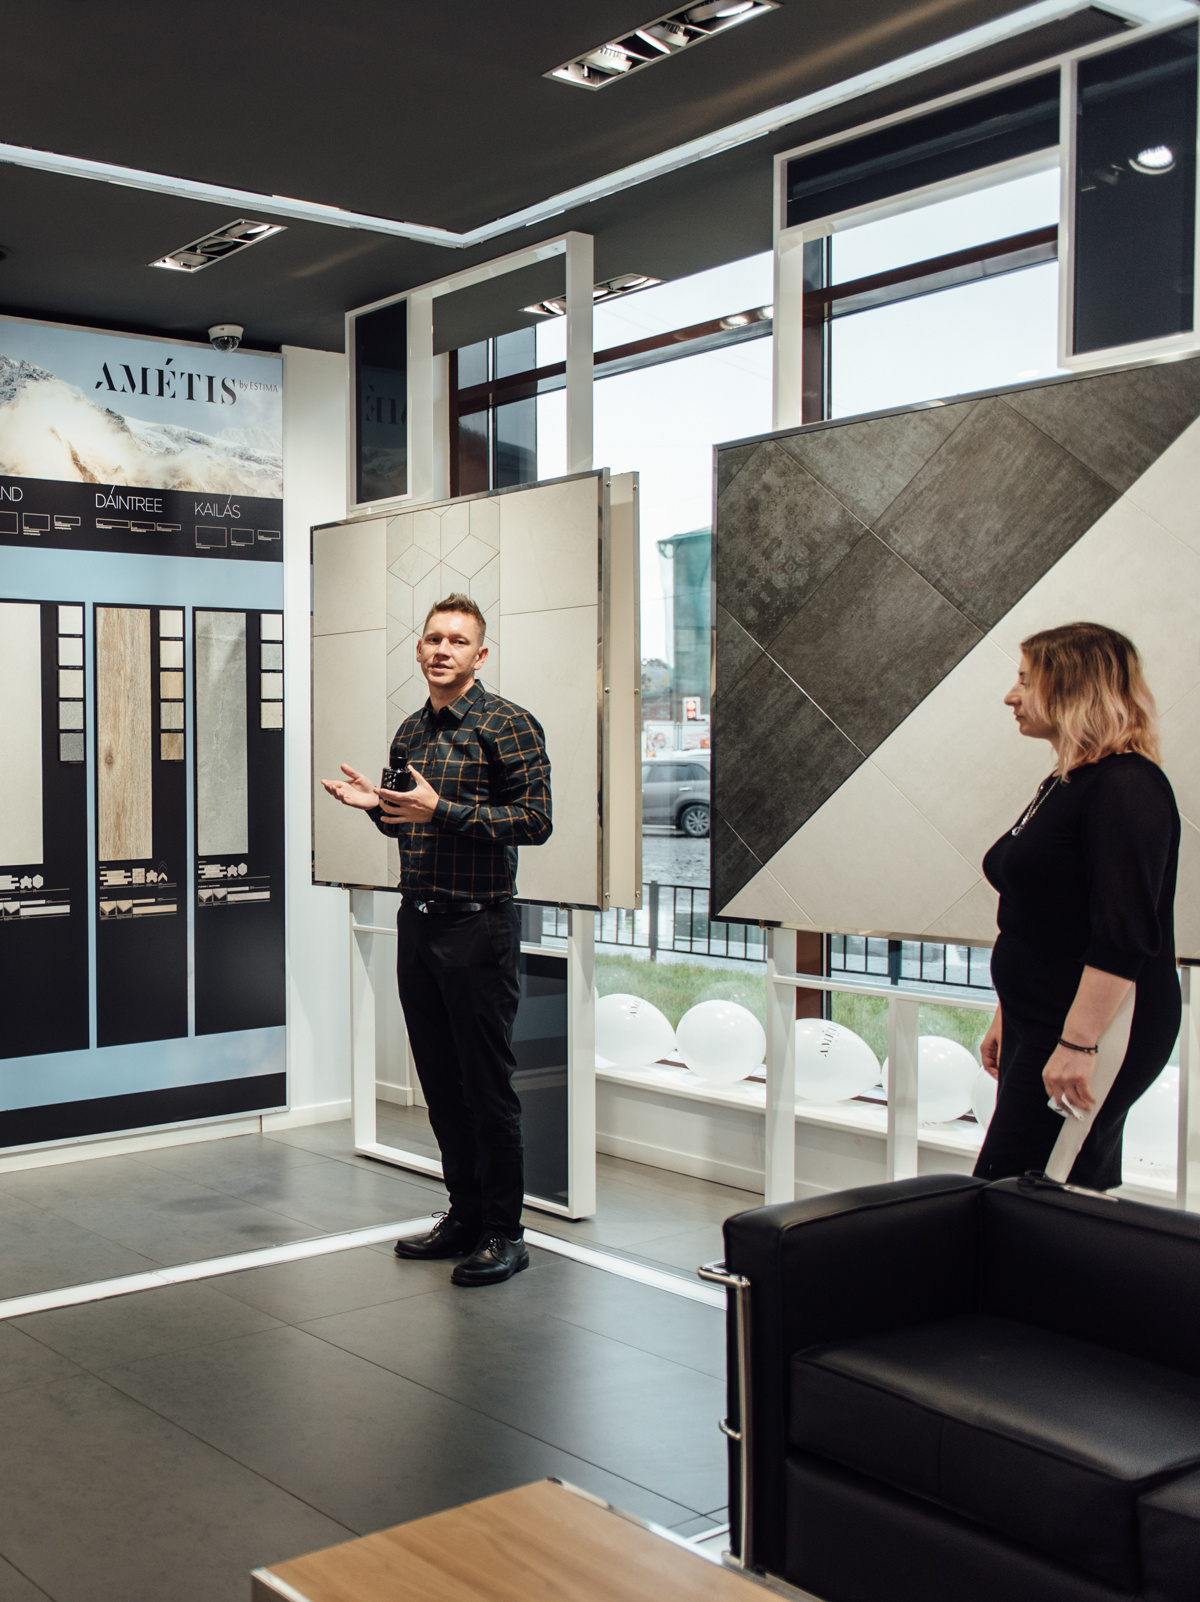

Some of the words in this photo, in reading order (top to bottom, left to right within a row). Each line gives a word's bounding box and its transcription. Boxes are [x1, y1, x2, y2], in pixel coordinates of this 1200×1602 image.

[94, 357, 238, 406] AMÉTIS
[239, 379, 249, 392] by
[250, 381, 278, 393] ESTIMA
